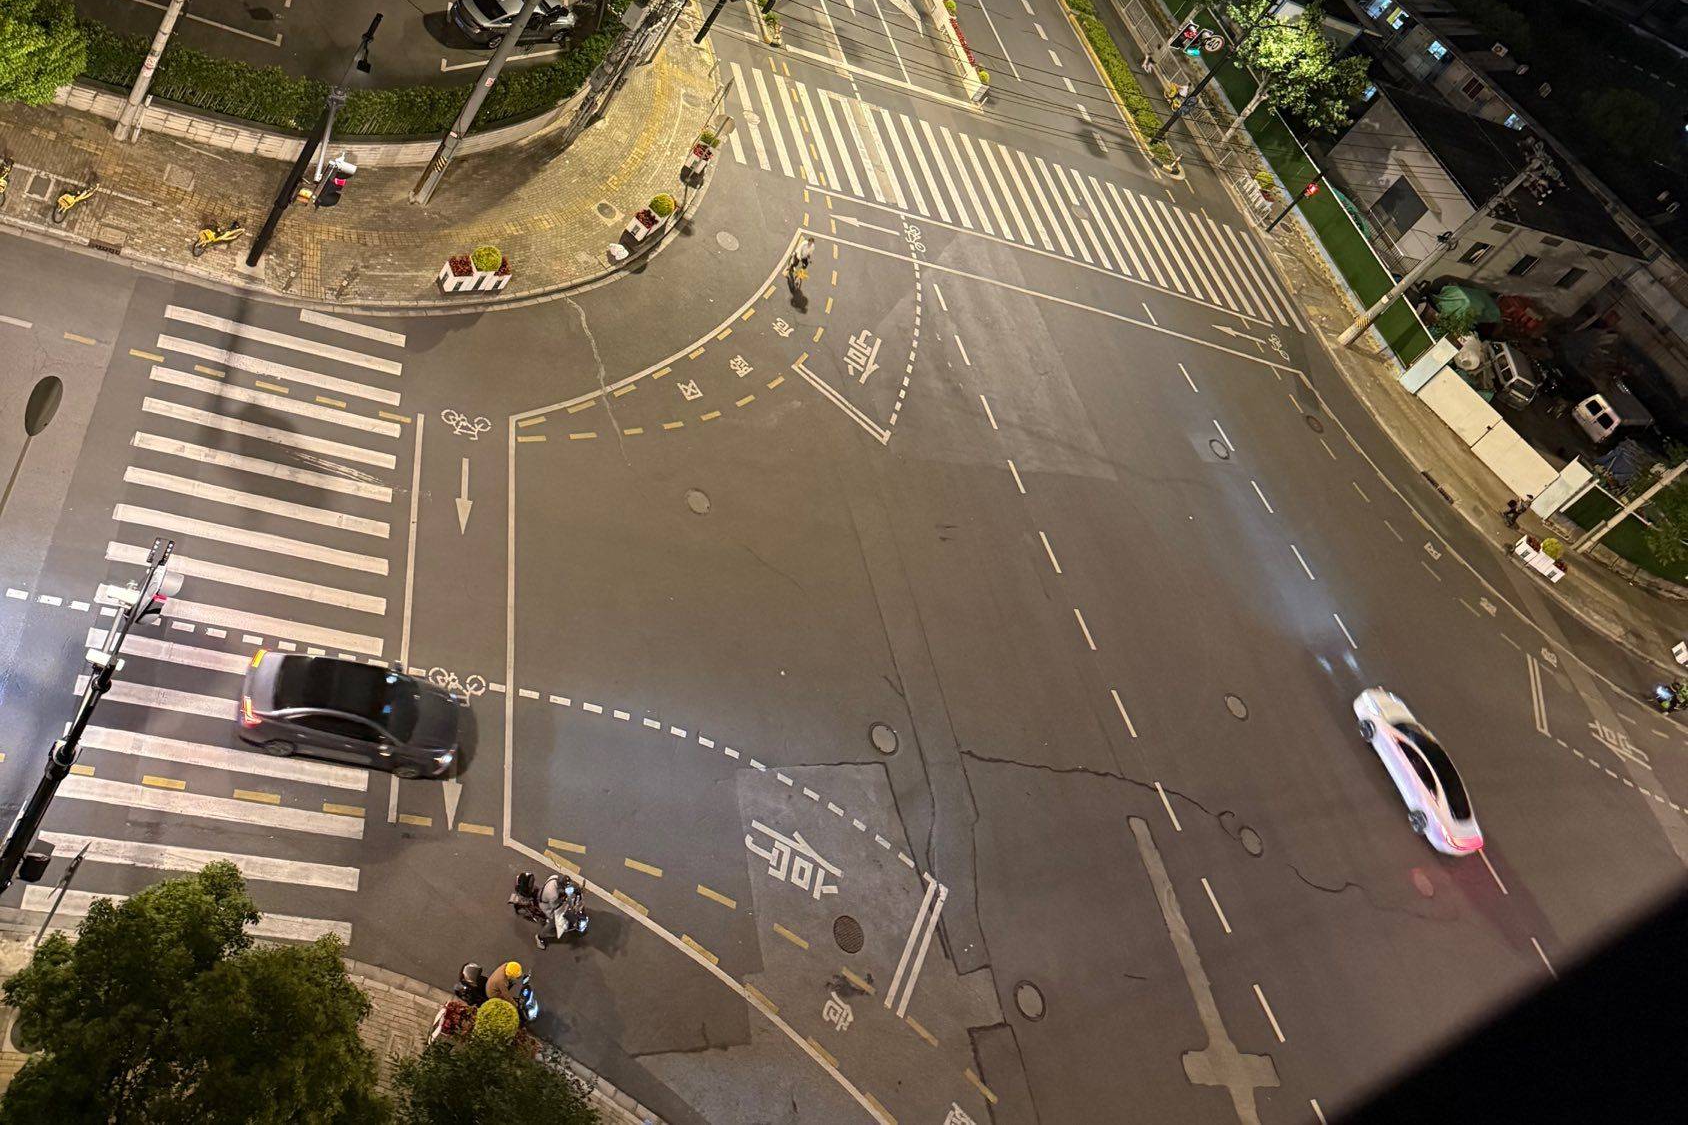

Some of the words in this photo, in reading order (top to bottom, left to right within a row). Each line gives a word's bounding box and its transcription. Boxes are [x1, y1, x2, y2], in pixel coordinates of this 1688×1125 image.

[843, 329, 882, 385] 停
[1588, 720, 1652, 771] 停
[744, 819, 843, 901] 停
